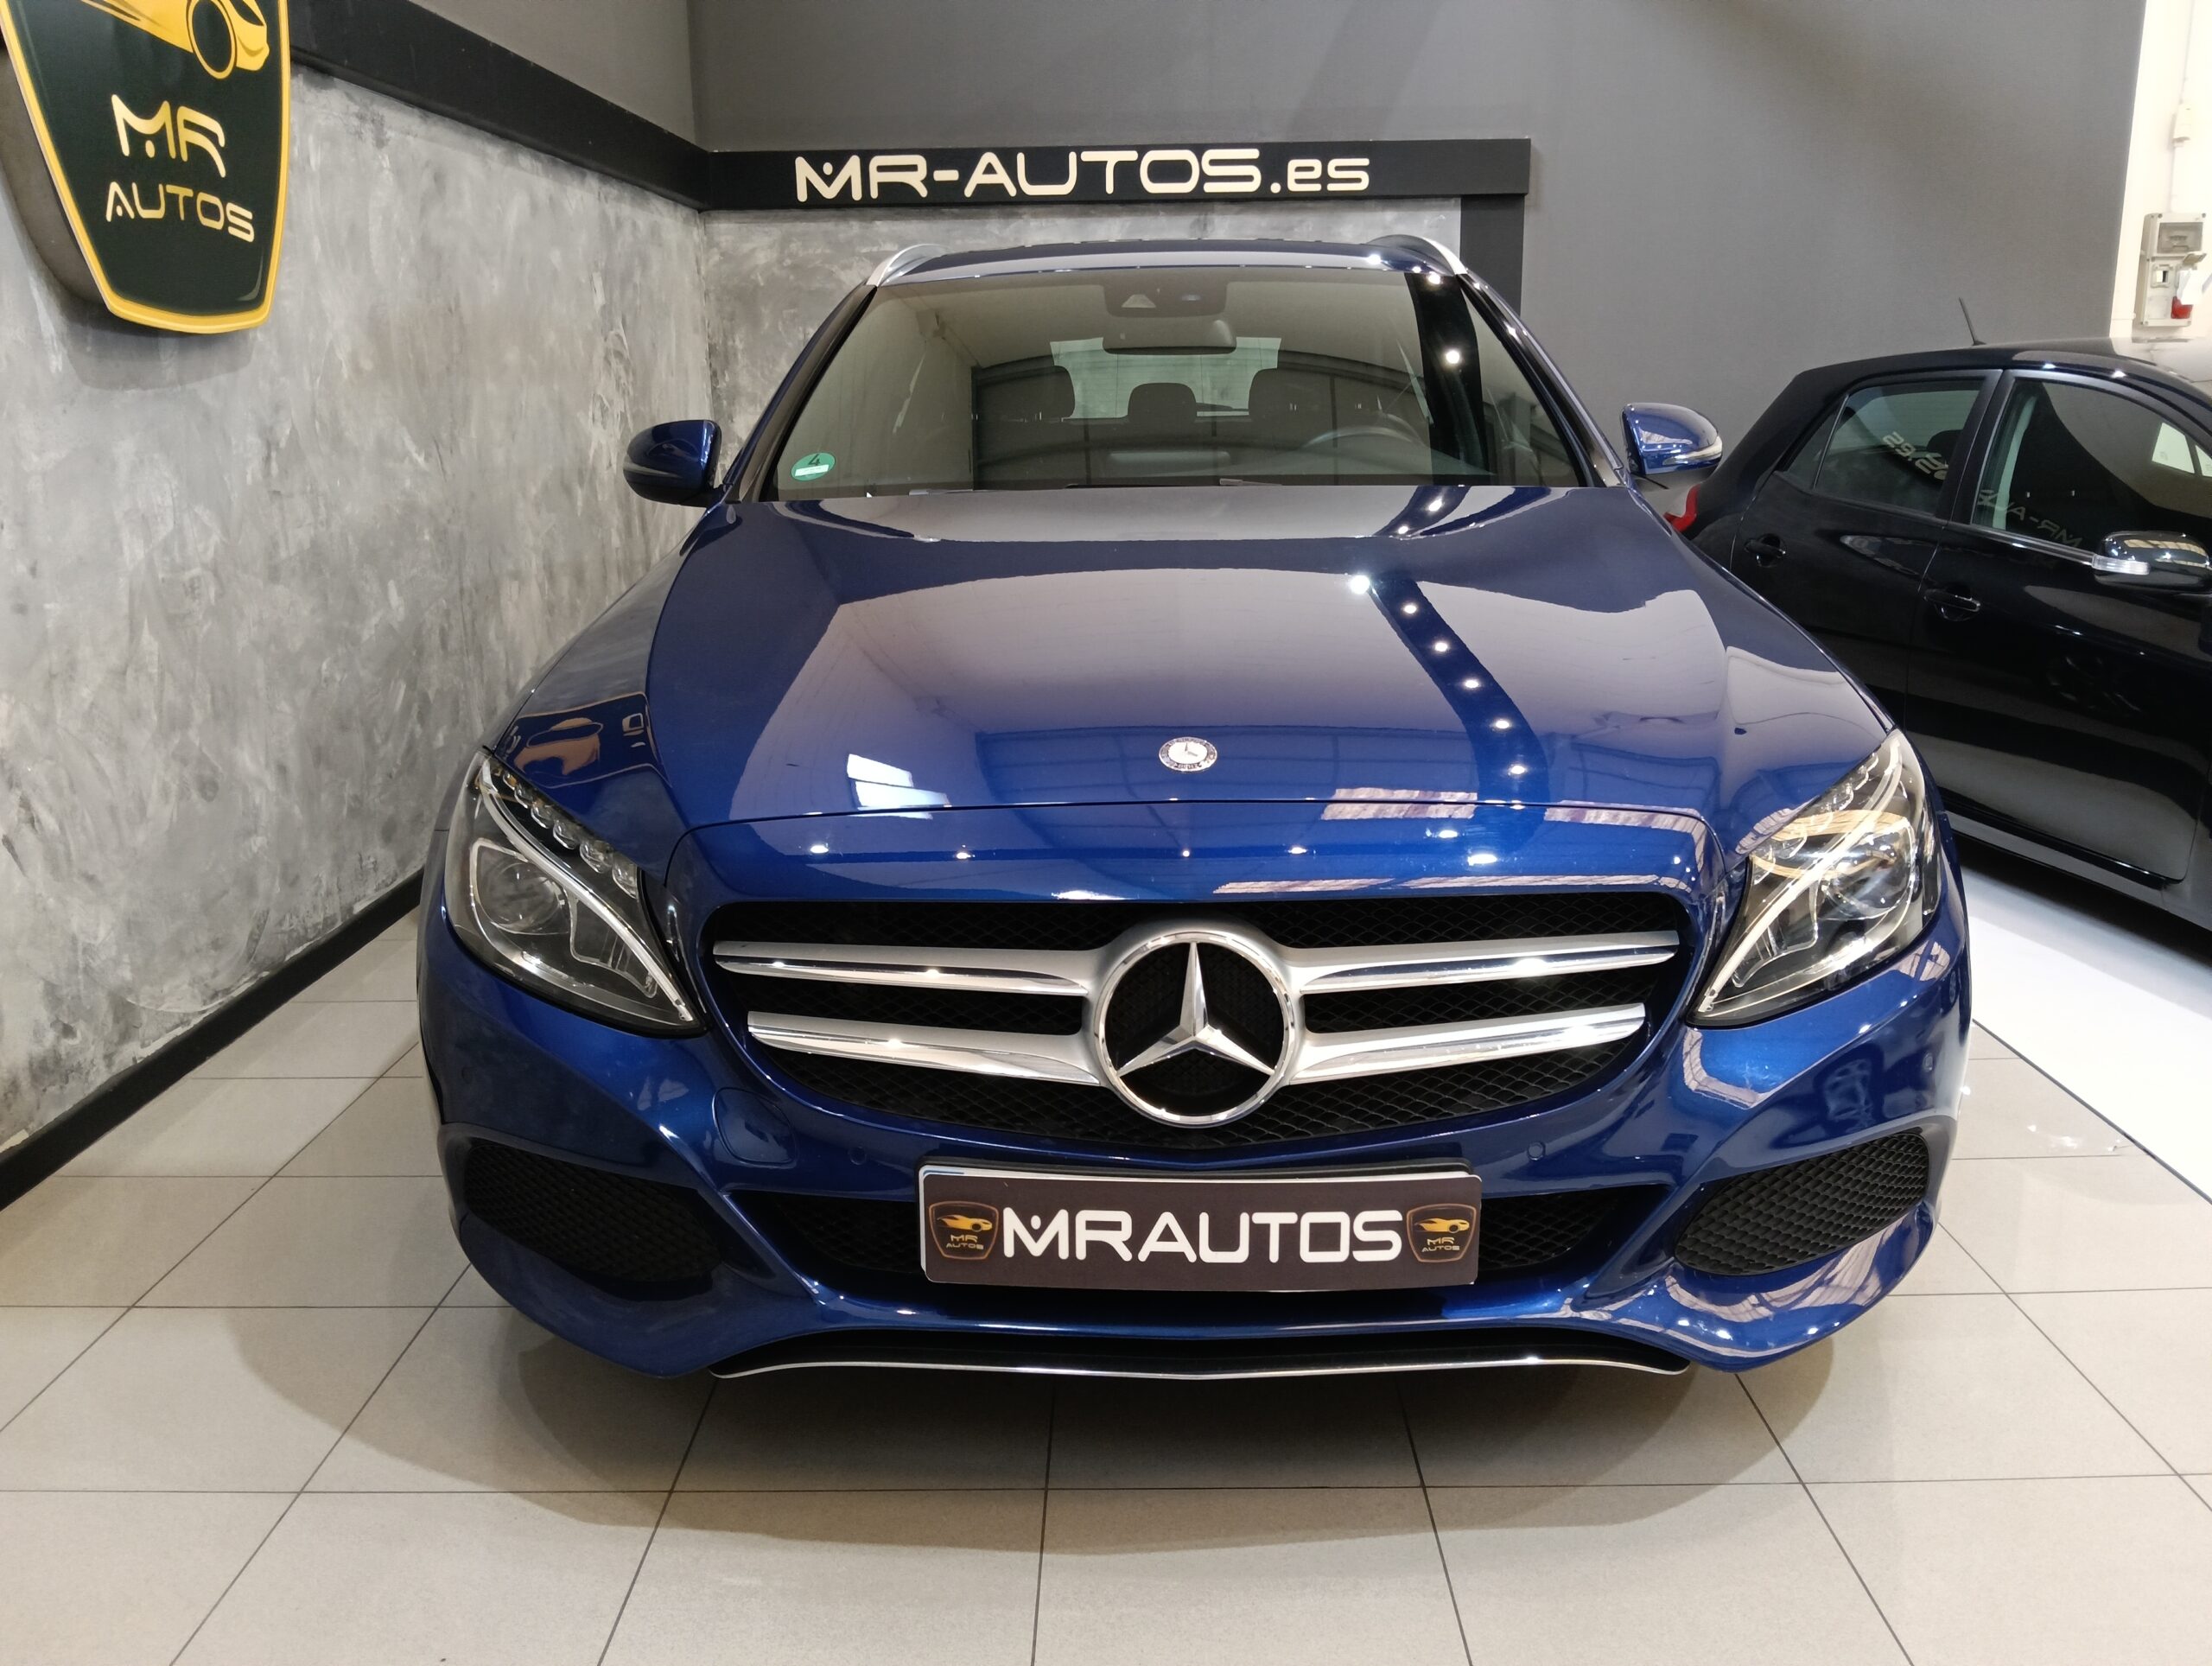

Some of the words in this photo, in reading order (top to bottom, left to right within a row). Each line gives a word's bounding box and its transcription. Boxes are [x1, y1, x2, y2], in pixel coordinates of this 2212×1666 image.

[111, 93, 226, 178] MR
[794, 148, 1371, 202] MR-AUTOS.es
[105, 181, 255, 243] AUTOS
[950, 1234, 978, 1243] MR
[1002, 1206, 1403, 1263] MRAUTOS
[1427, 1237, 1455, 1245] MR
